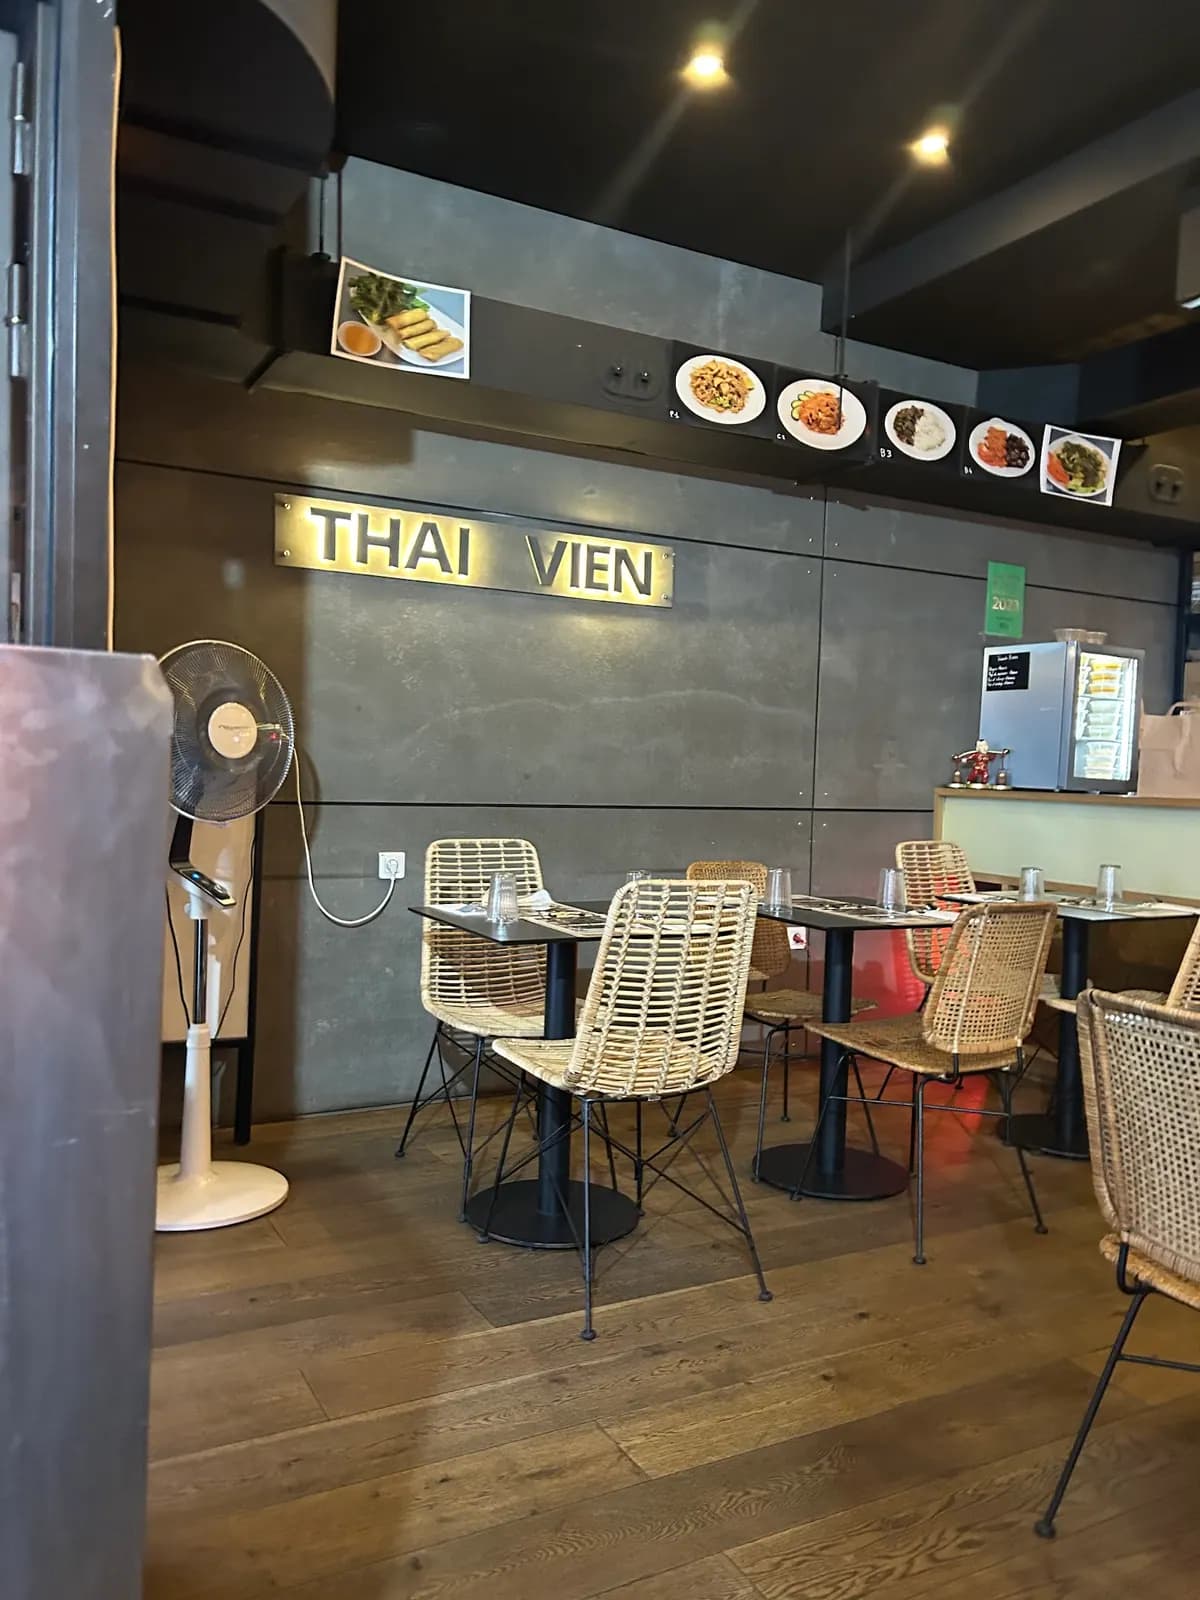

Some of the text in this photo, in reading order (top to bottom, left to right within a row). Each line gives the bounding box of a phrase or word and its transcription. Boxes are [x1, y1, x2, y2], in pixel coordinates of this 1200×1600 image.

[880, 447, 892, 458] B3
[310, 506, 653, 596] THAI VIEN
